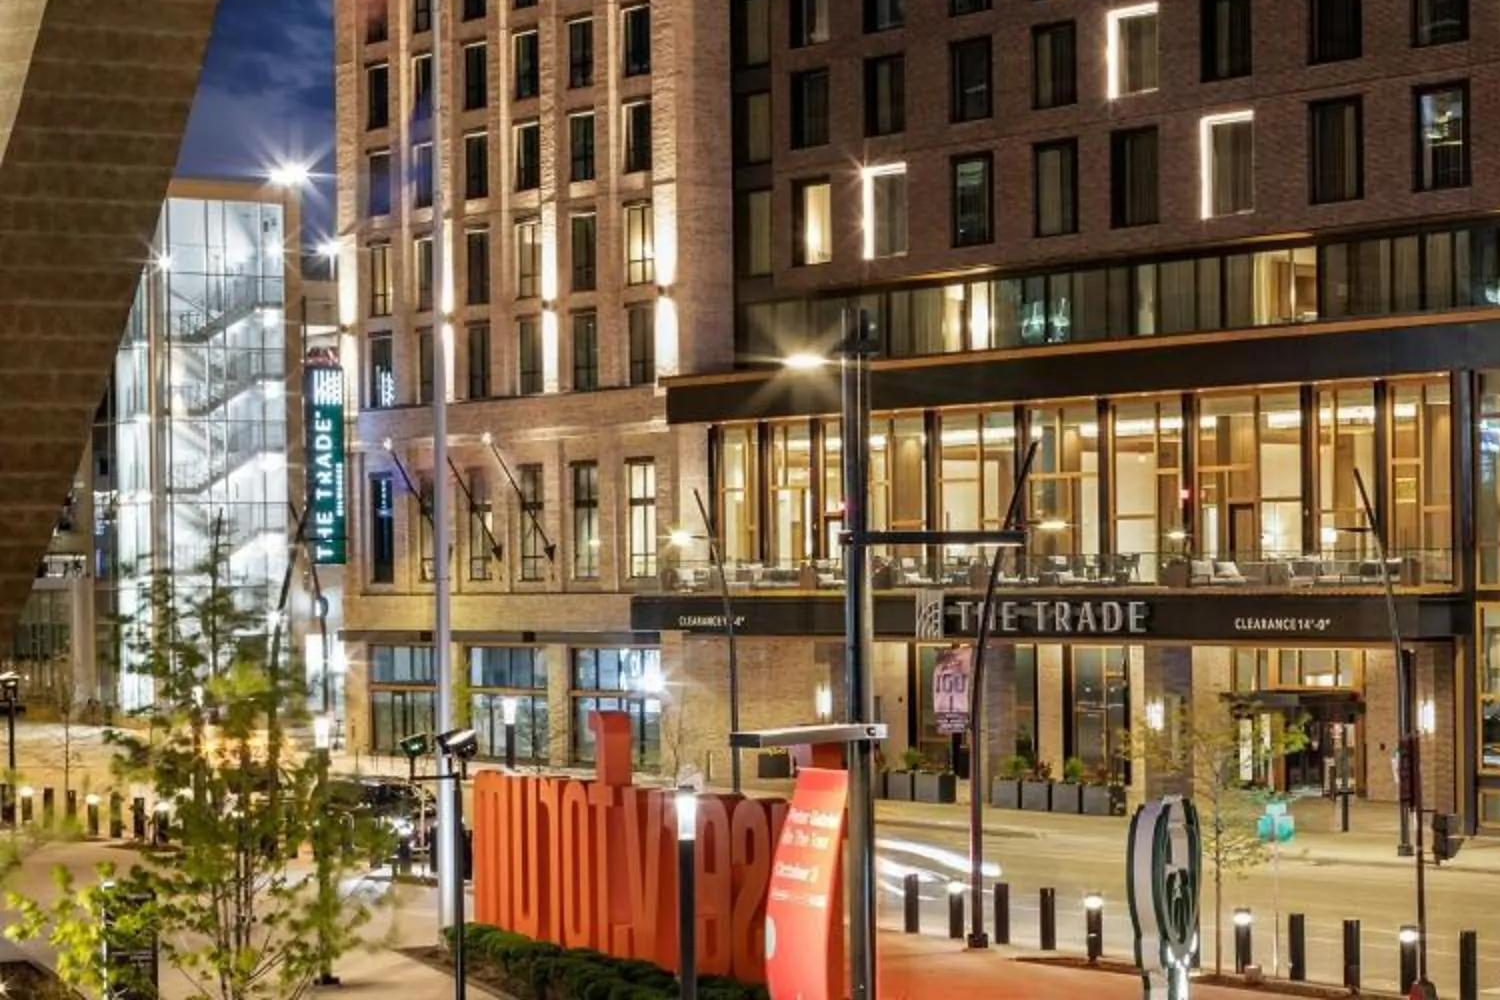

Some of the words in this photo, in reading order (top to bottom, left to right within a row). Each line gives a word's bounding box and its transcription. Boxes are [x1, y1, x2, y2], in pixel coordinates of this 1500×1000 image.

[315, 510, 334, 560] THE
[956, 601, 1018, 632] THE
[1032, 601, 1148, 633] TRADE
[1234, 617, 1297, 631] CLEARANCE
